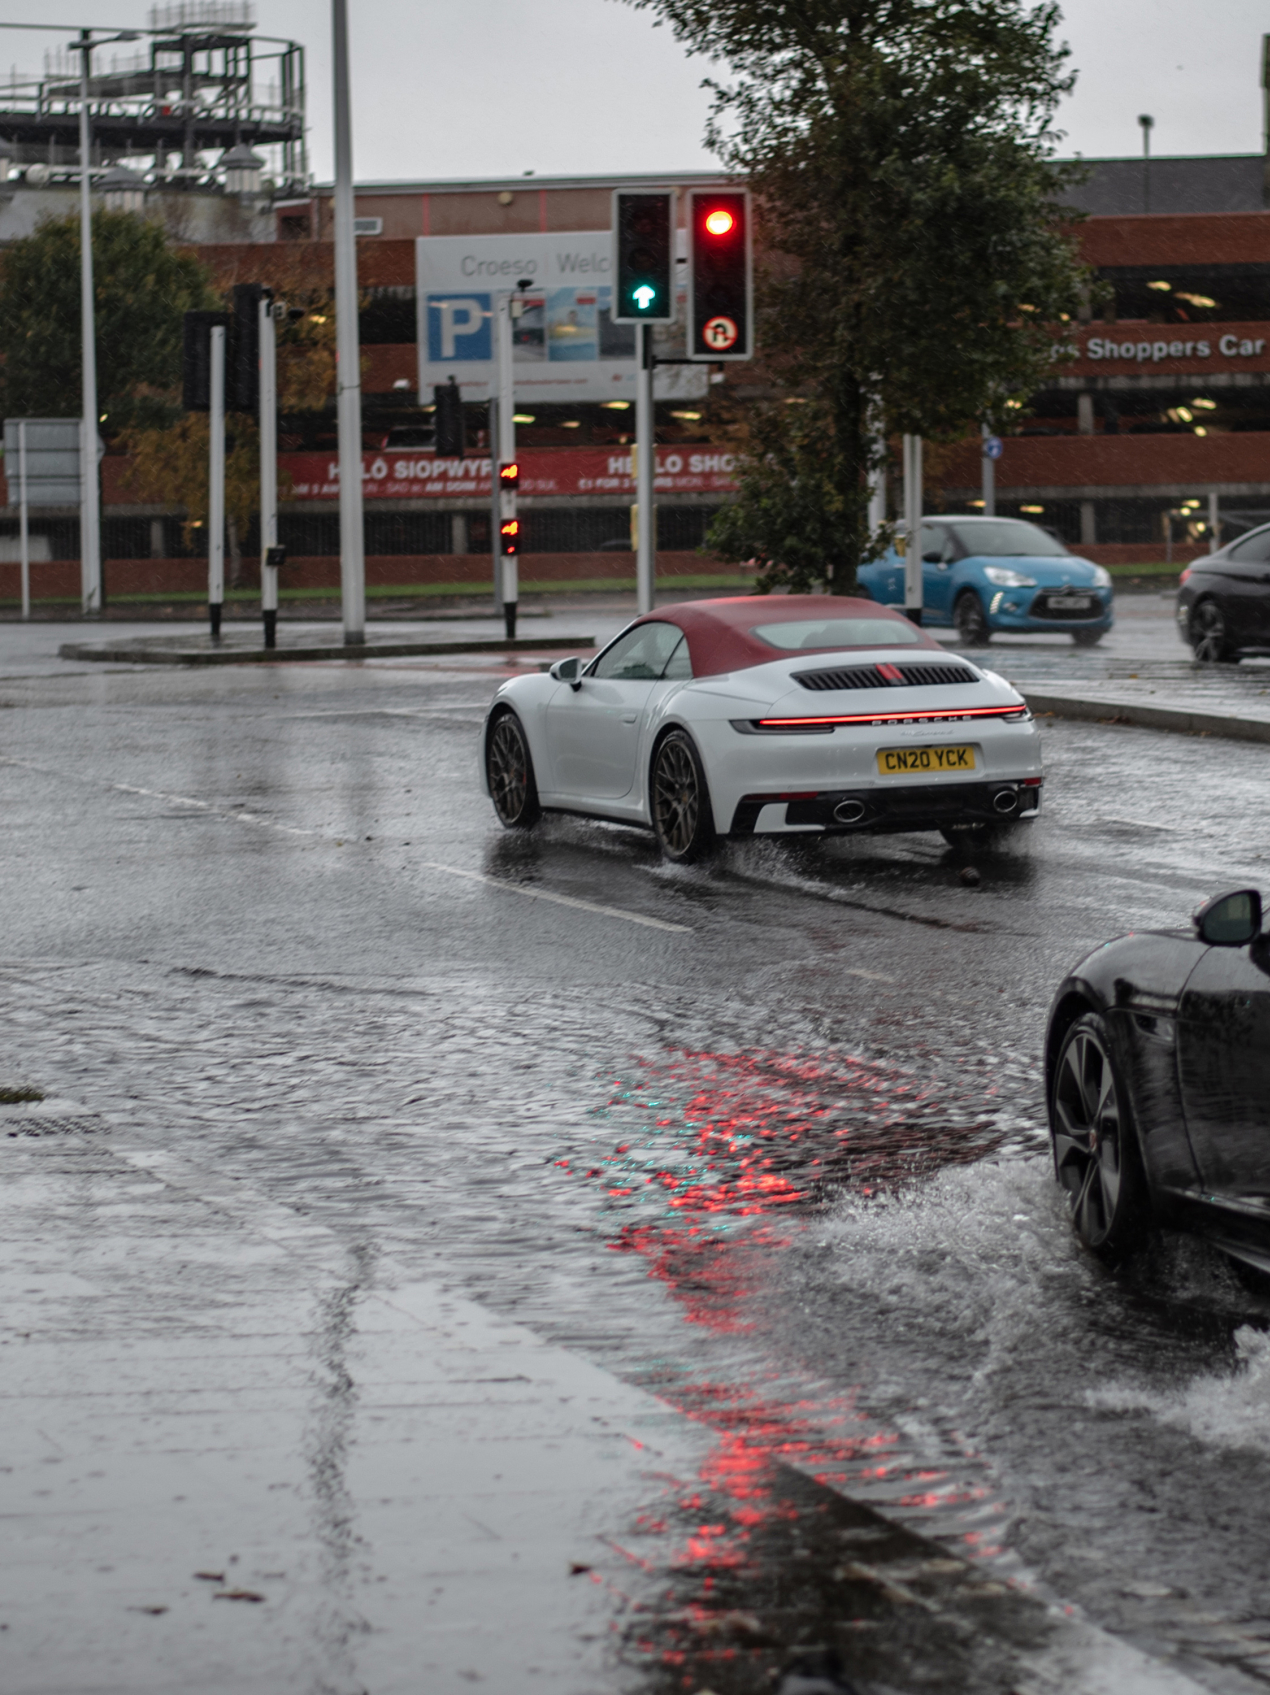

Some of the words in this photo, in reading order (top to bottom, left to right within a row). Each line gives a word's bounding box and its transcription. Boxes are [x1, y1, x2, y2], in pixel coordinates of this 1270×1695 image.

[460, 254, 538, 277] Croeso
[440, 299, 484, 358] P
[1086, 335, 1212, 362] Shoppers
[1217, 334, 1266, 358] Car
[871, 714, 972, 727] PORSCHE
[885, 750, 931, 770] CN20
[933, 748, 969, 768] YCK
